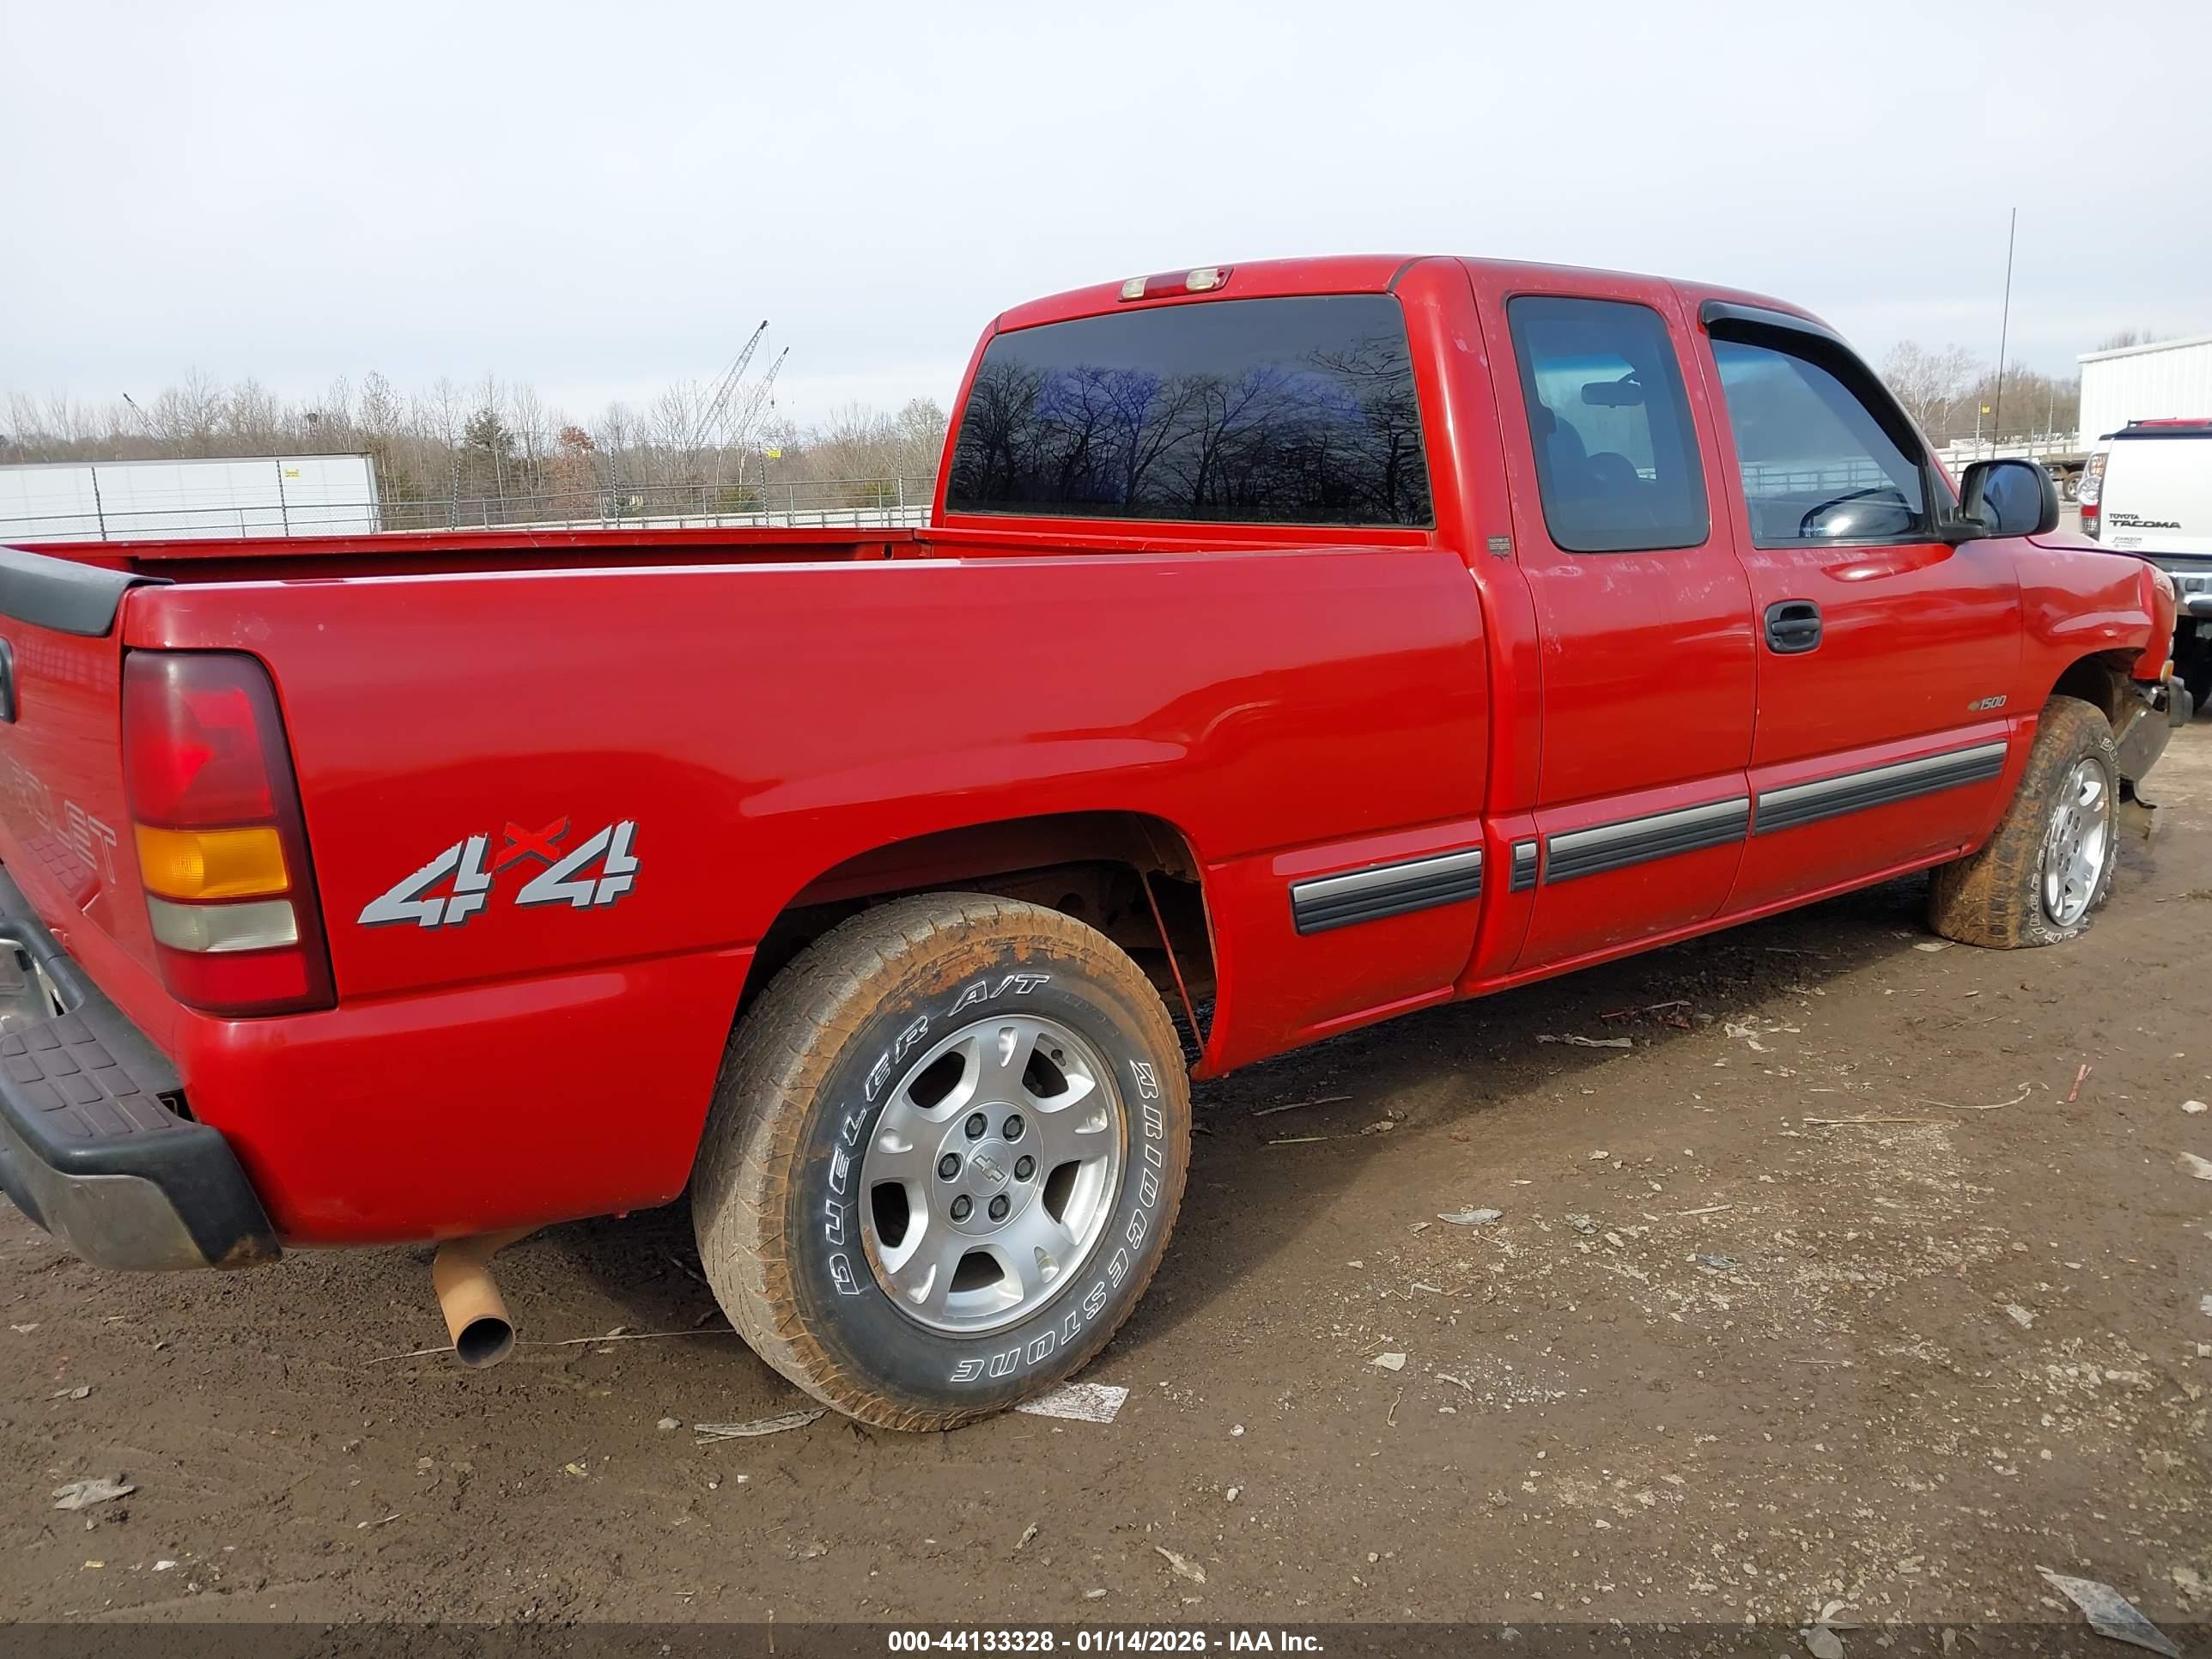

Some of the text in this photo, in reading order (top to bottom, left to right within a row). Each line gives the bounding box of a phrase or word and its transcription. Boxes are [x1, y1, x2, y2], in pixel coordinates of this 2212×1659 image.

[2109, 520, 2182, 529] TACOMA
[1980, 695, 2007, 711] 1500
[825, 974, 1050, 1296] DUELER A/T
[950, 1059, 1163, 1382] BRIDGESTONE
